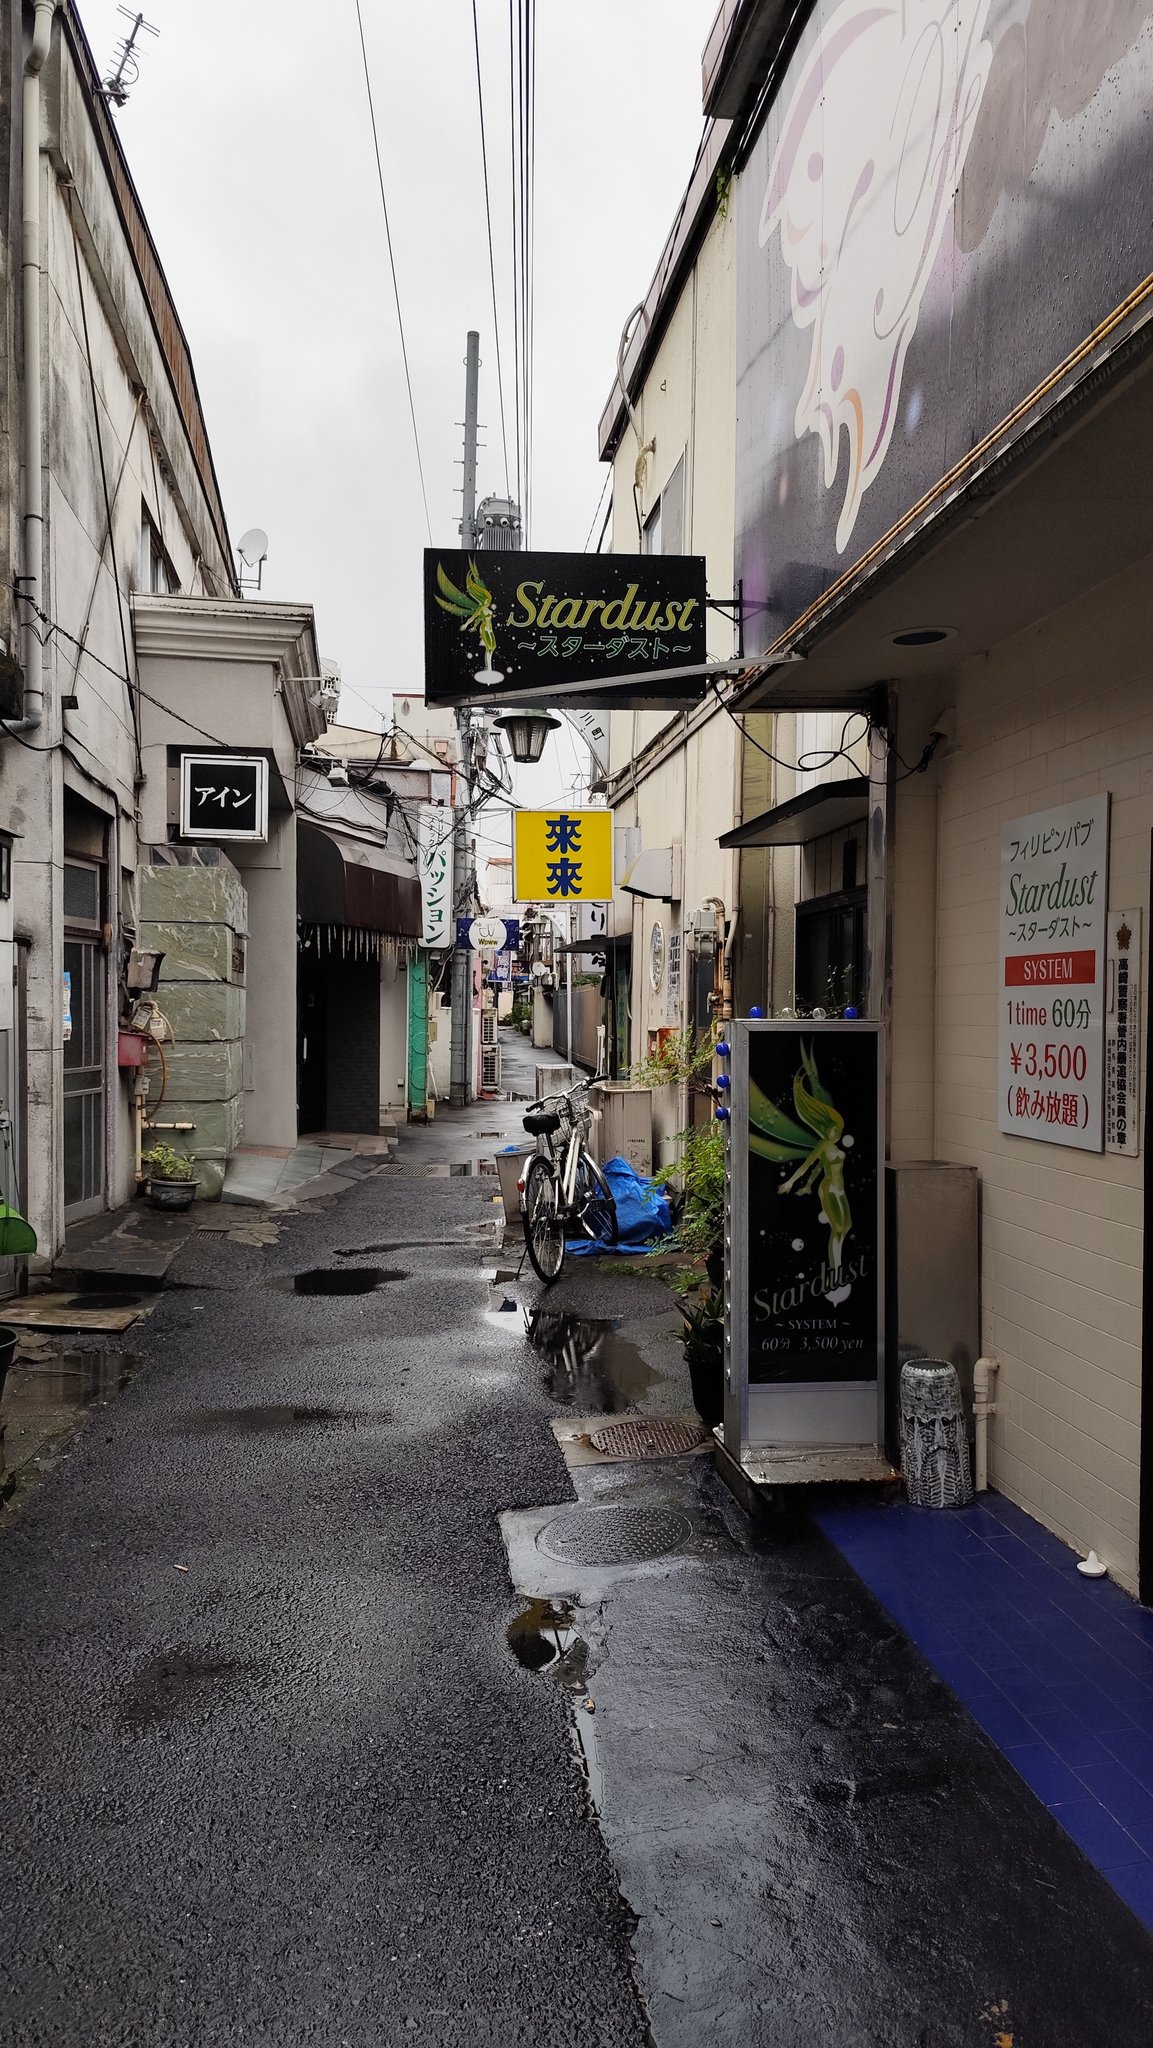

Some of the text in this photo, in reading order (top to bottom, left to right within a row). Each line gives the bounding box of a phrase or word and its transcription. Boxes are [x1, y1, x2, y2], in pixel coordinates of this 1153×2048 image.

[507, 580, 698, 631] Stardust
[195, 786, 252, 809] アイン
[1010, 818, 1095, 863] フィリピンパブ
[425, 850, 447, 945] パッション
[1005, 862, 1098, 917] Stardust
[1024, 957, 1073, 981] SYSTEM
[1052, 998, 1092, 1030] 60分
[1010, 1042, 1087, 1082] ¥3,500
[1007, 1085, 1089, 1130] (飲み放題)
[753, 1254, 869, 1323] Stardust
[788, 1319, 837, 1331] SYSTEM
[800, 1335, 838, 1353] 3,500
[839, 1337, 864, 1354] yen
